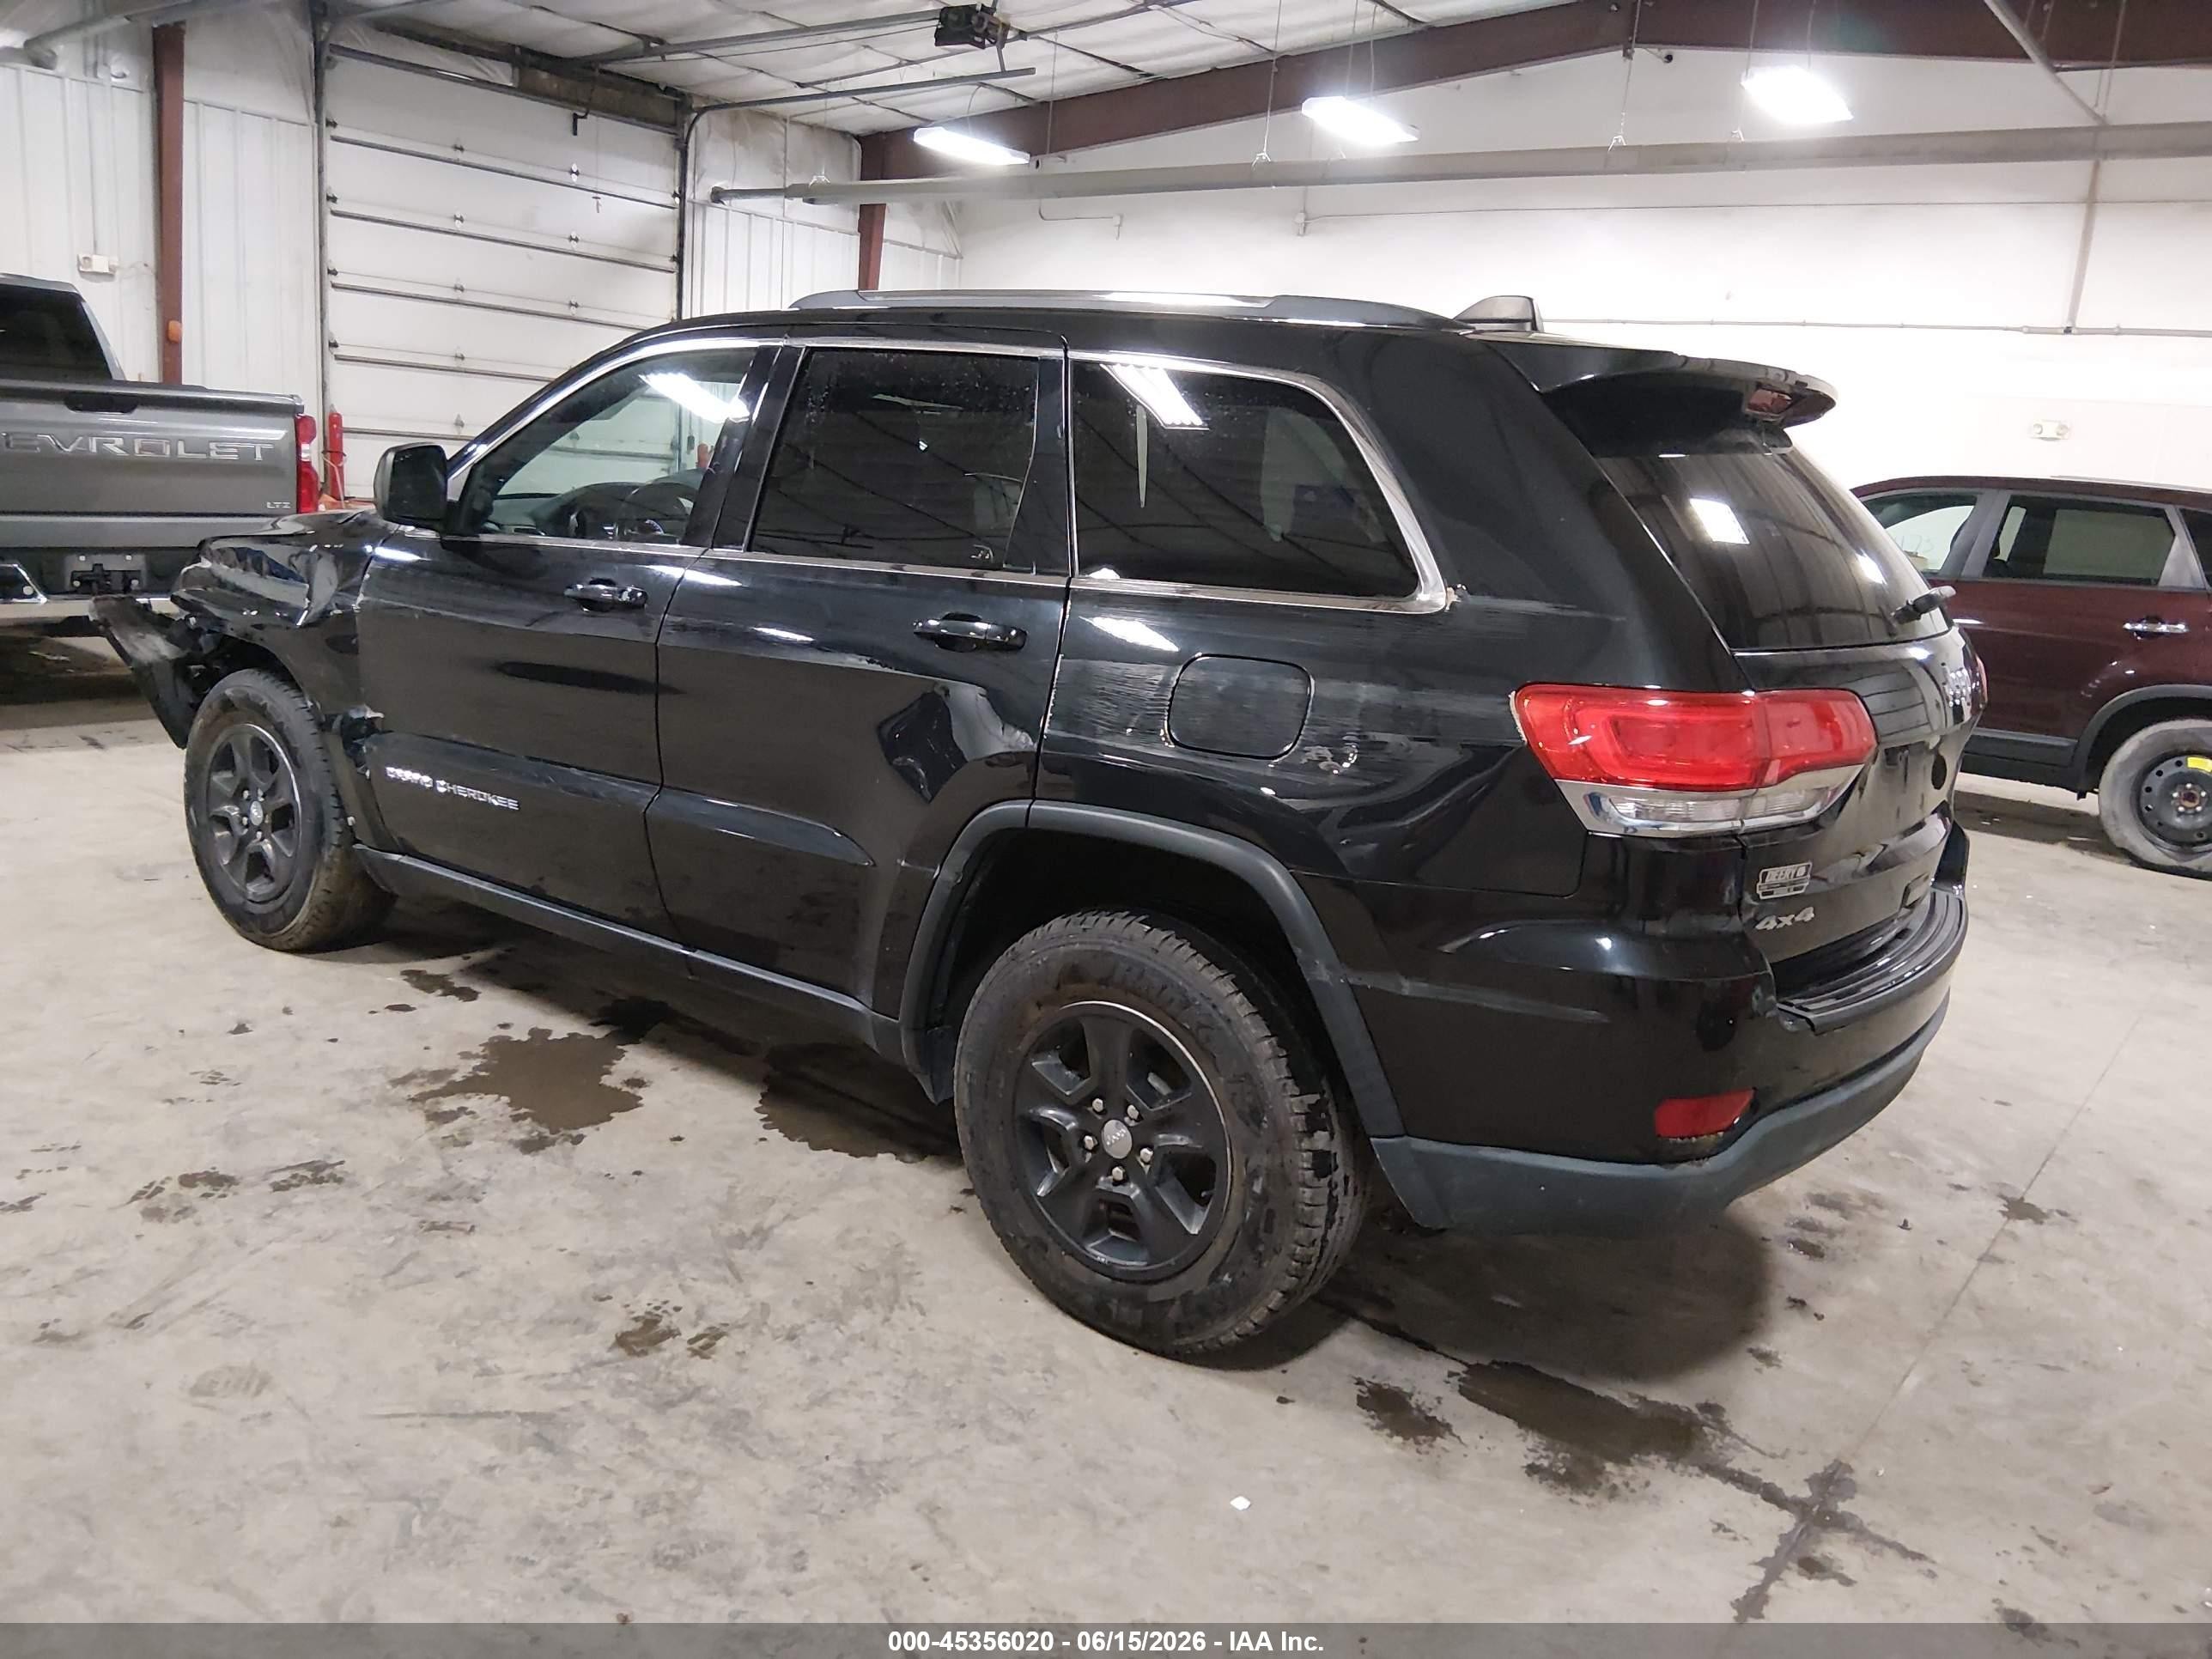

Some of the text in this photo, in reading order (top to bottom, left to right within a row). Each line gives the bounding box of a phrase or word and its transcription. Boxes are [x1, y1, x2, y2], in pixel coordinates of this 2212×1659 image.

[0, 431, 275, 462] EVROLET
[435, 780, 520, 811] CHEROKEE
[1755, 907, 1815, 931] 4x4
